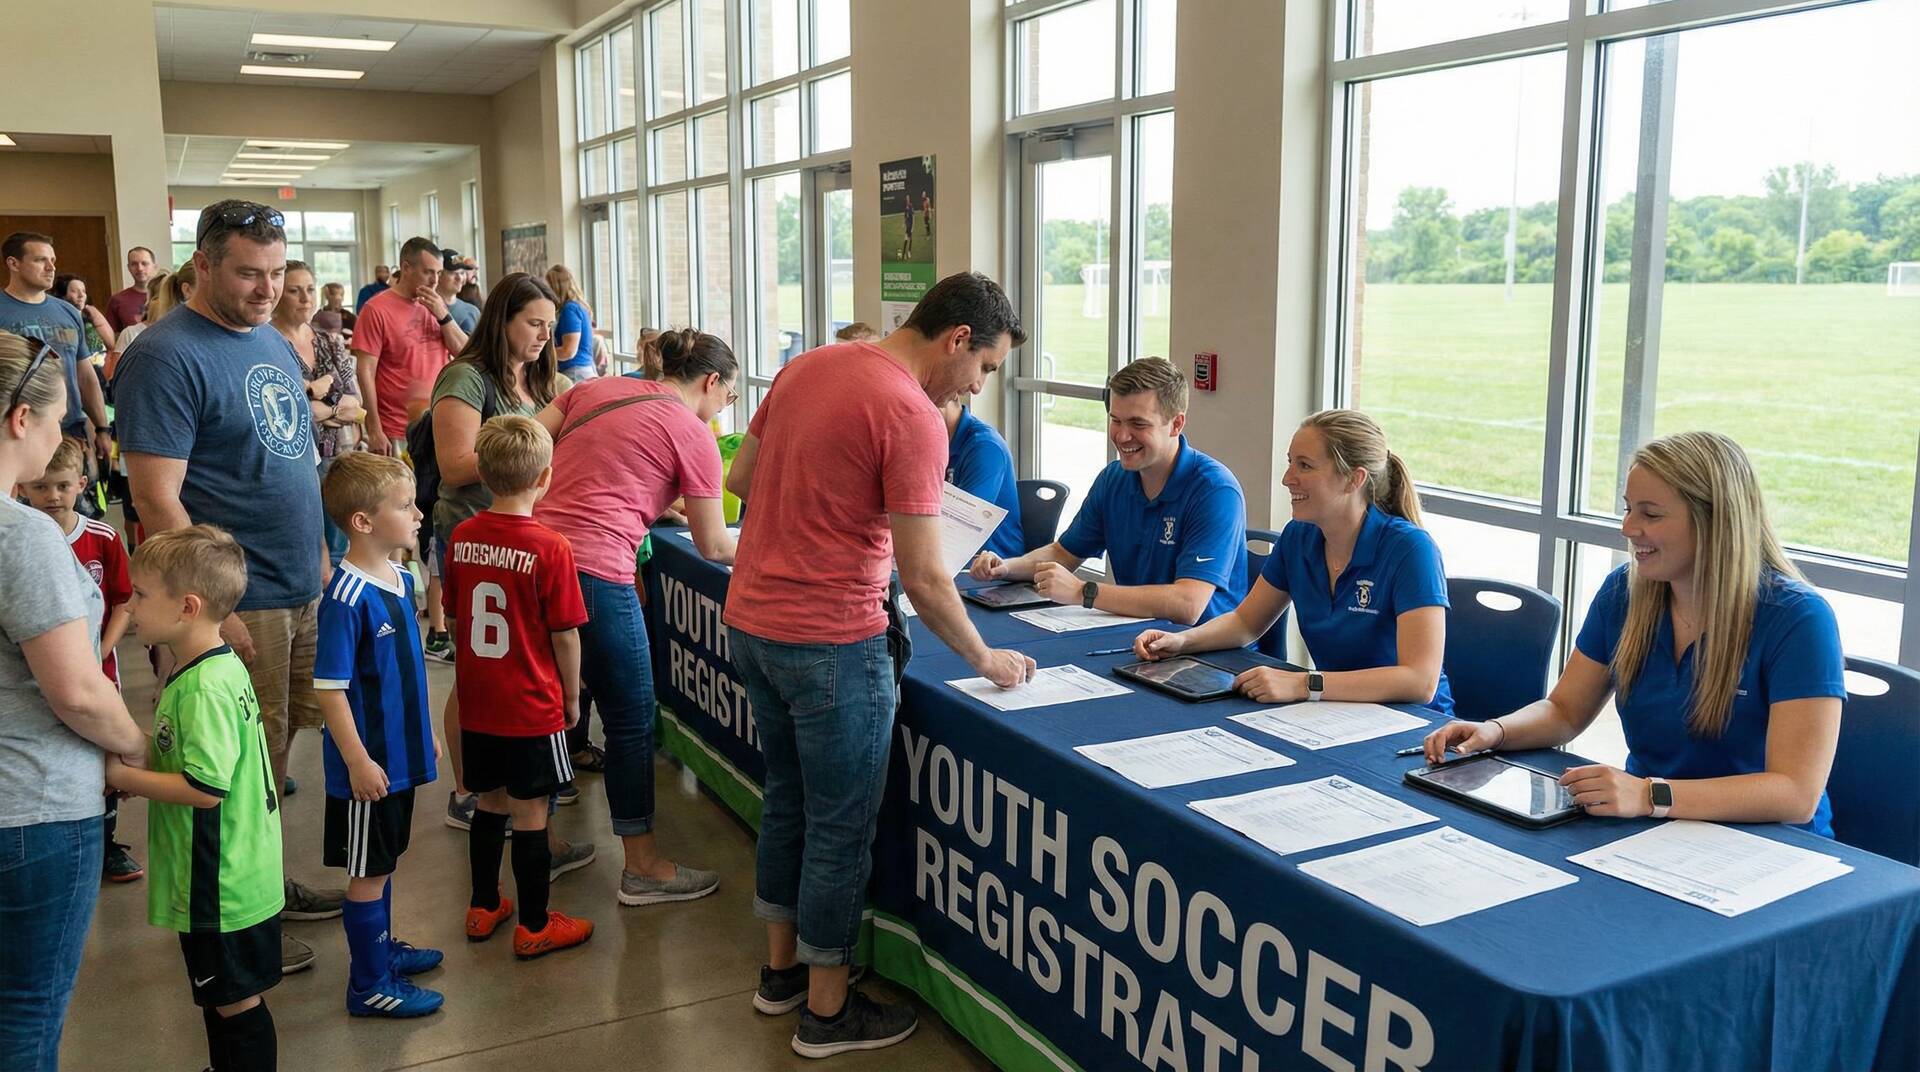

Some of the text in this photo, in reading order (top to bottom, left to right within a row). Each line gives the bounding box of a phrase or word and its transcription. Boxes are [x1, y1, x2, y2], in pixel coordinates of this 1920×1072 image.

[470, 581, 510, 659] 6
[660, 572, 730, 663] YOUTH
[901, 723, 1435, 1072] YOUTH SOCCER
[916, 827, 1260, 1072] REGISTRAT
